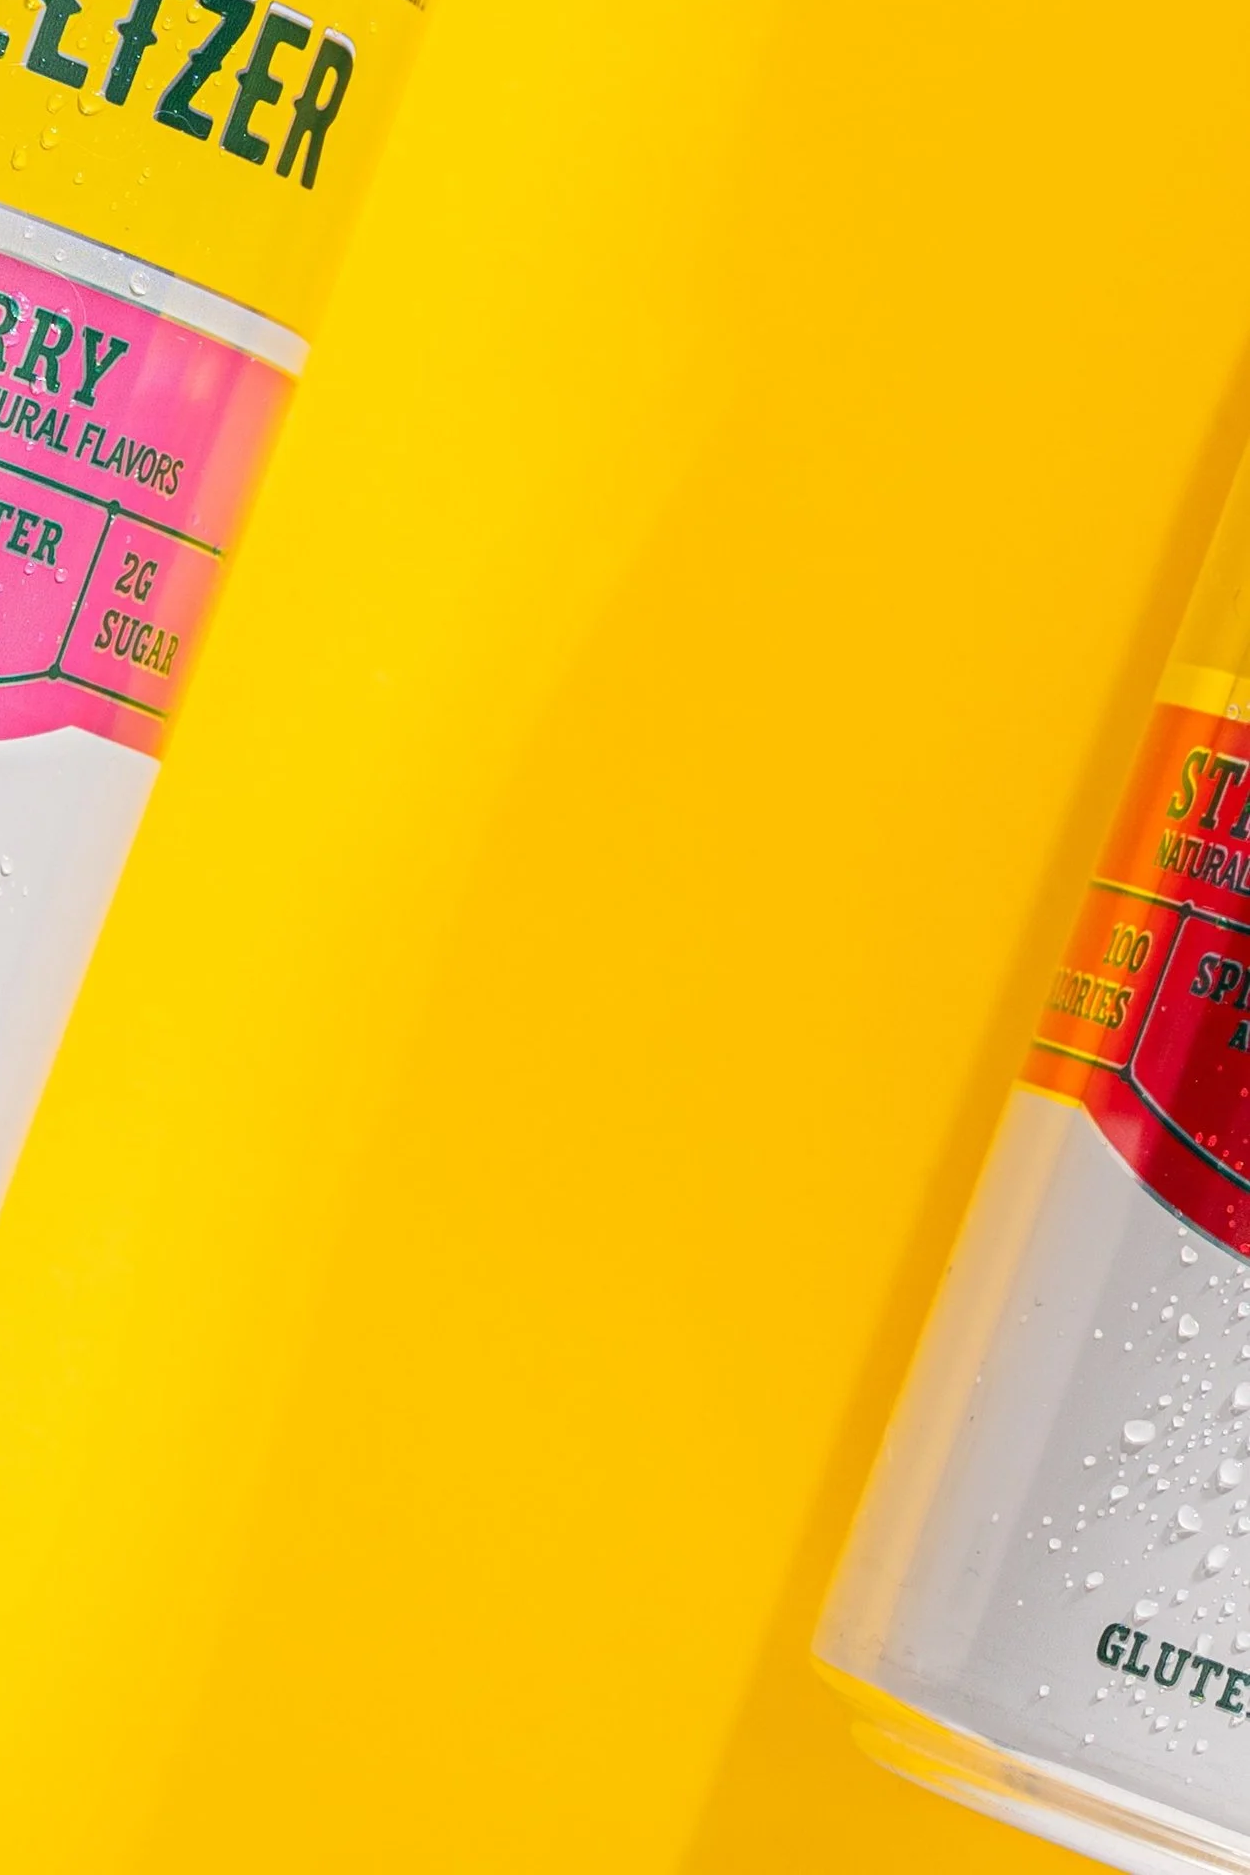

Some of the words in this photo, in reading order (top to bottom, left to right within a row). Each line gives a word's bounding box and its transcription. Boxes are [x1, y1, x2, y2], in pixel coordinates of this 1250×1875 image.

[74, 419, 186, 500] FLAVORS
[113, 551, 159, 606] 2G
[93, 609, 181, 681] SUGAR
[1103, 921, 1153, 974] 100
[1096, 1622, 1250, 1718] GLUTE
